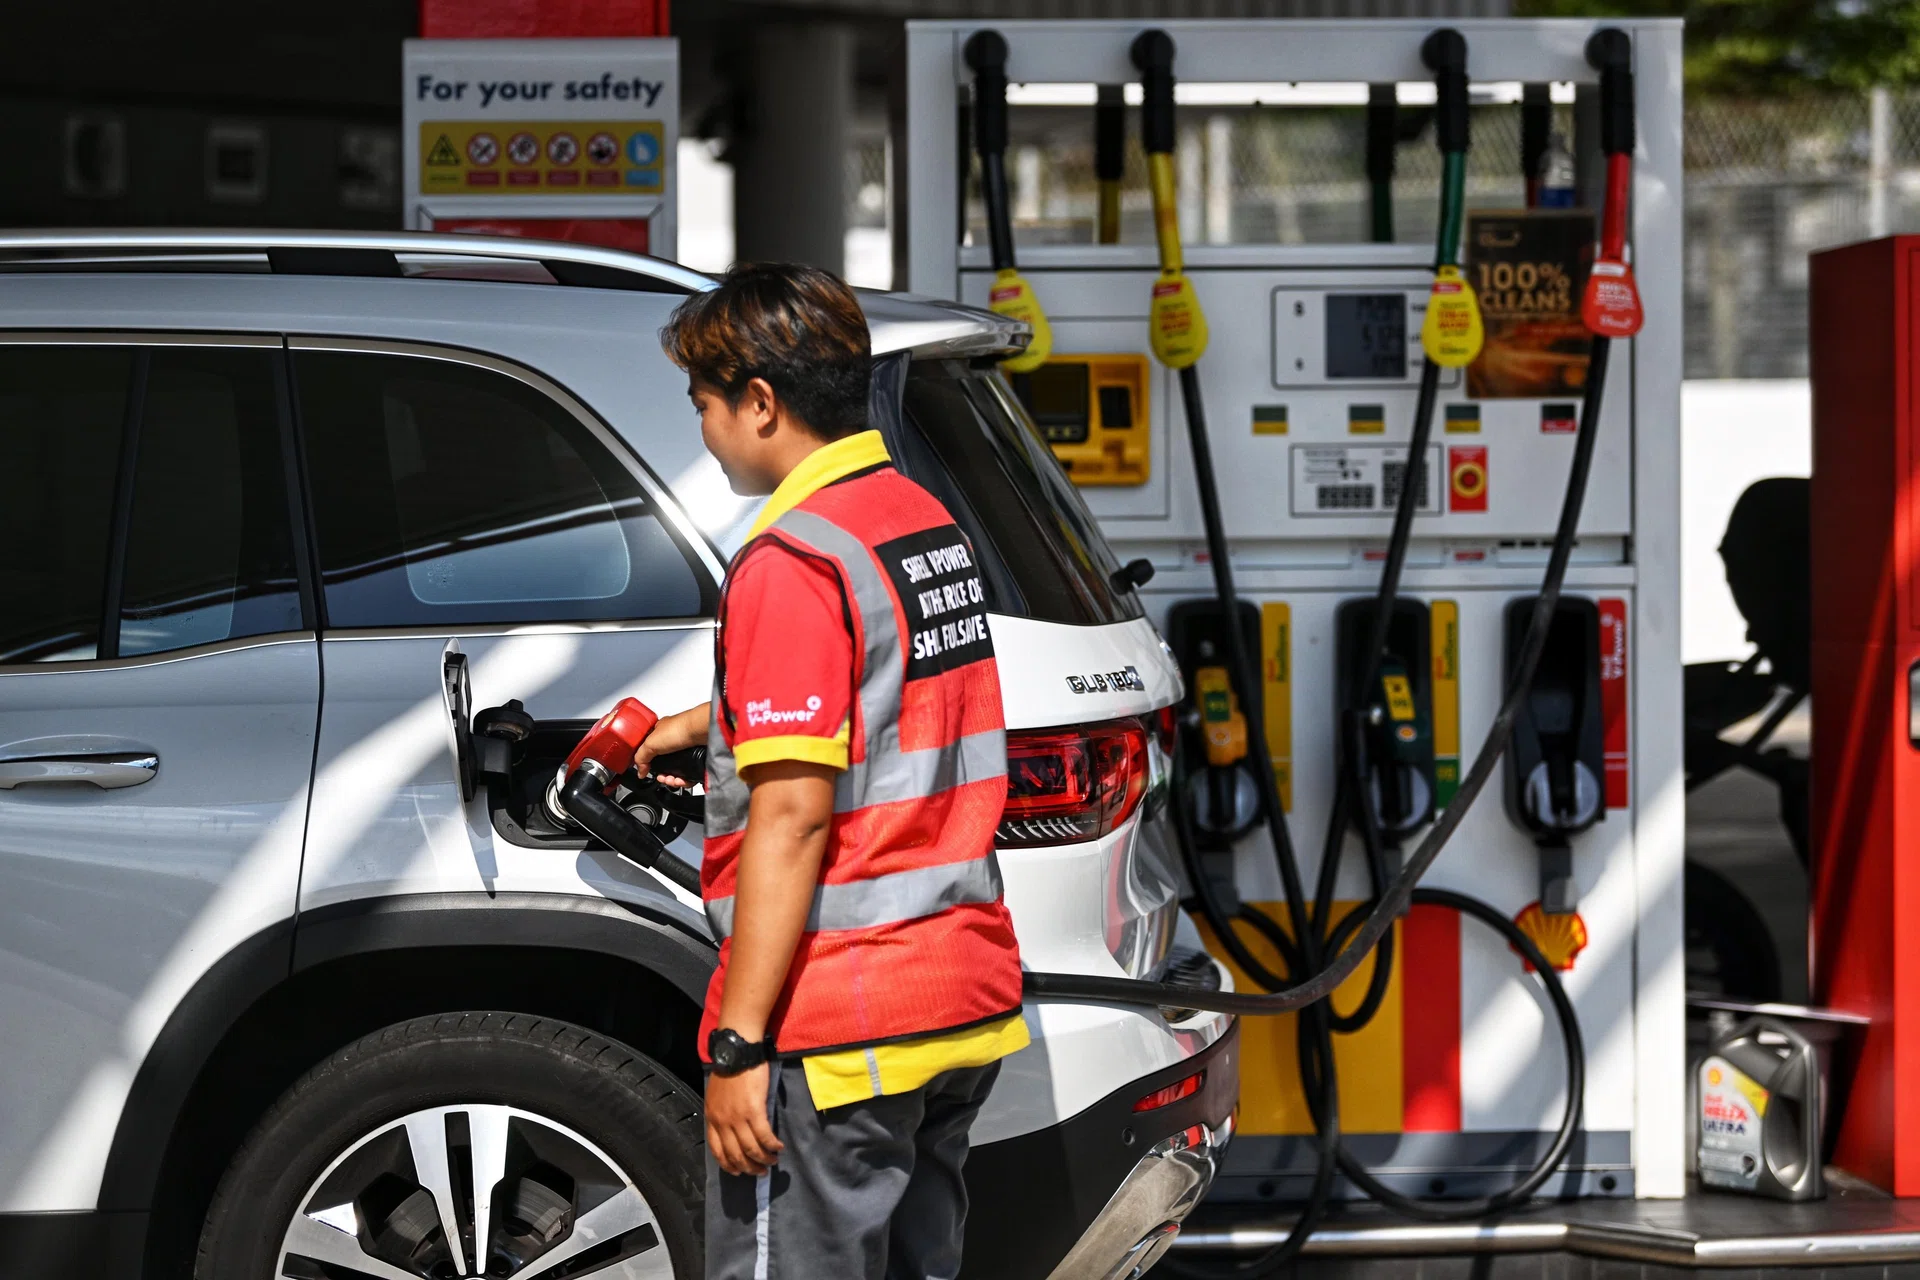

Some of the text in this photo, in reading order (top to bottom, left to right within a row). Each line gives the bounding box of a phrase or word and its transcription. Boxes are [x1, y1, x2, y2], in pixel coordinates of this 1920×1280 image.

[417, 71, 664, 108] For your safety
[1478, 262, 1571, 290] 100%
[1066, 674, 1108, 694] GLB
[746, 698, 771, 713] Shell
[747, 709, 816, 727] V-Power
